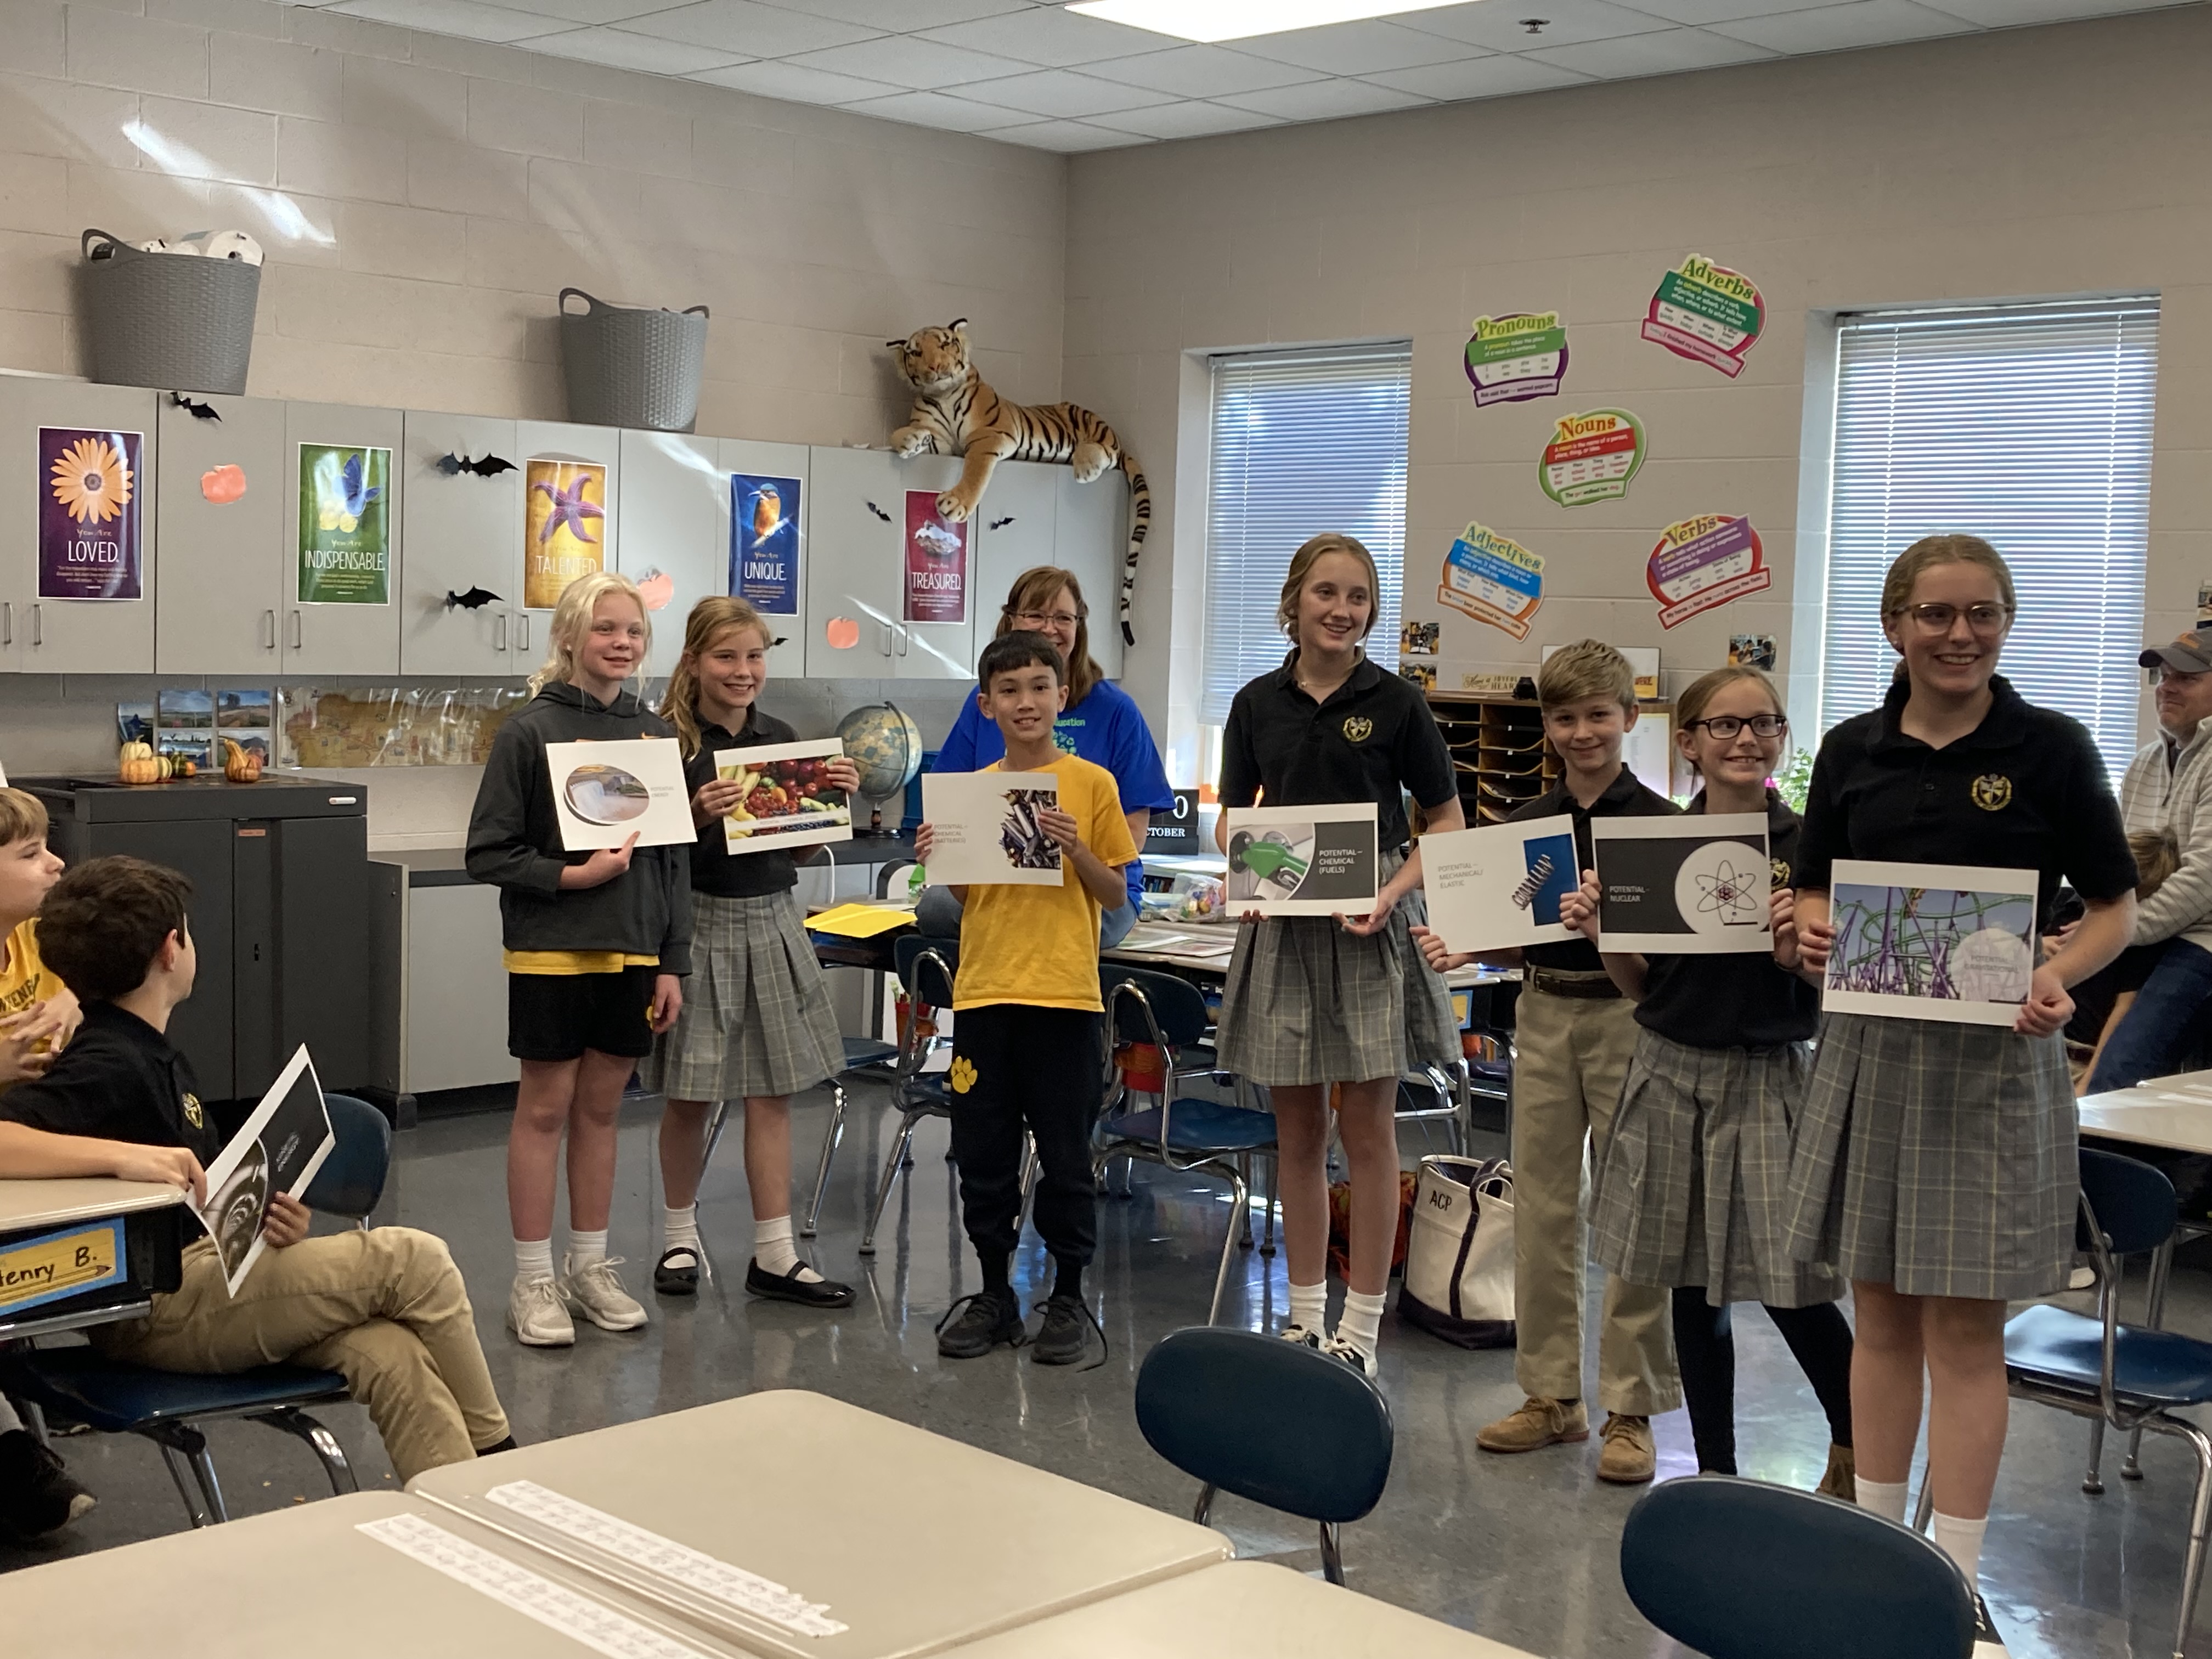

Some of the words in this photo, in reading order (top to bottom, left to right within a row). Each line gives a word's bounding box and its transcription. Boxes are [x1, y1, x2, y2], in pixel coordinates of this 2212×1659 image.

[1683, 259, 1754, 300] Adverbs
[1476, 315, 1555, 338] Pronouns
[1559, 417, 1616, 441] Nouns
[1664, 517, 1716, 546] Verbs
[68, 540, 120, 562] LOVED.
[1464, 526, 1541, 569] Adjectives
[1146, 827, 1186, 837] CTOBER
[1437, 862, 1472, 872] POTENTIAL
[1440, 880, 1465, 888] ELASTIC
[1429, 1190, 1452, 1211] ACP
[75, 1246, 97, 1267] B.
